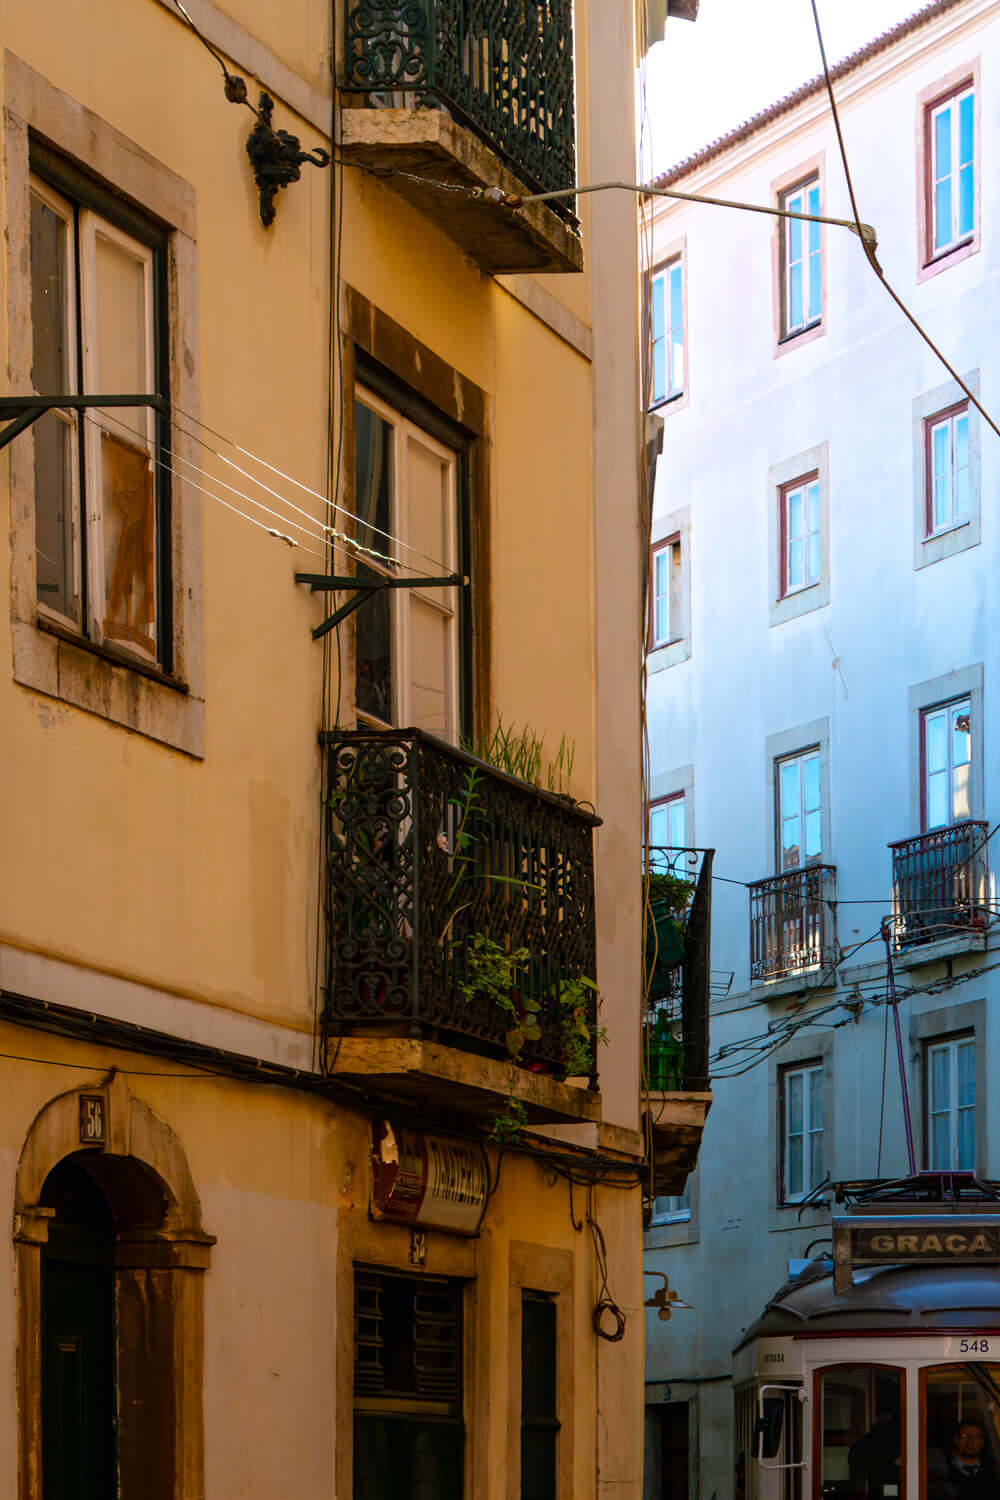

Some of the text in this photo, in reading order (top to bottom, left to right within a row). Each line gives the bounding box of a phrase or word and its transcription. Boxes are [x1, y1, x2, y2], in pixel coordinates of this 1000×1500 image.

[87, 1101, 102, 1138] 56
[870, 1233, 992, 1254] GRAÇA
[960, 1339, 989, 1352] 548
